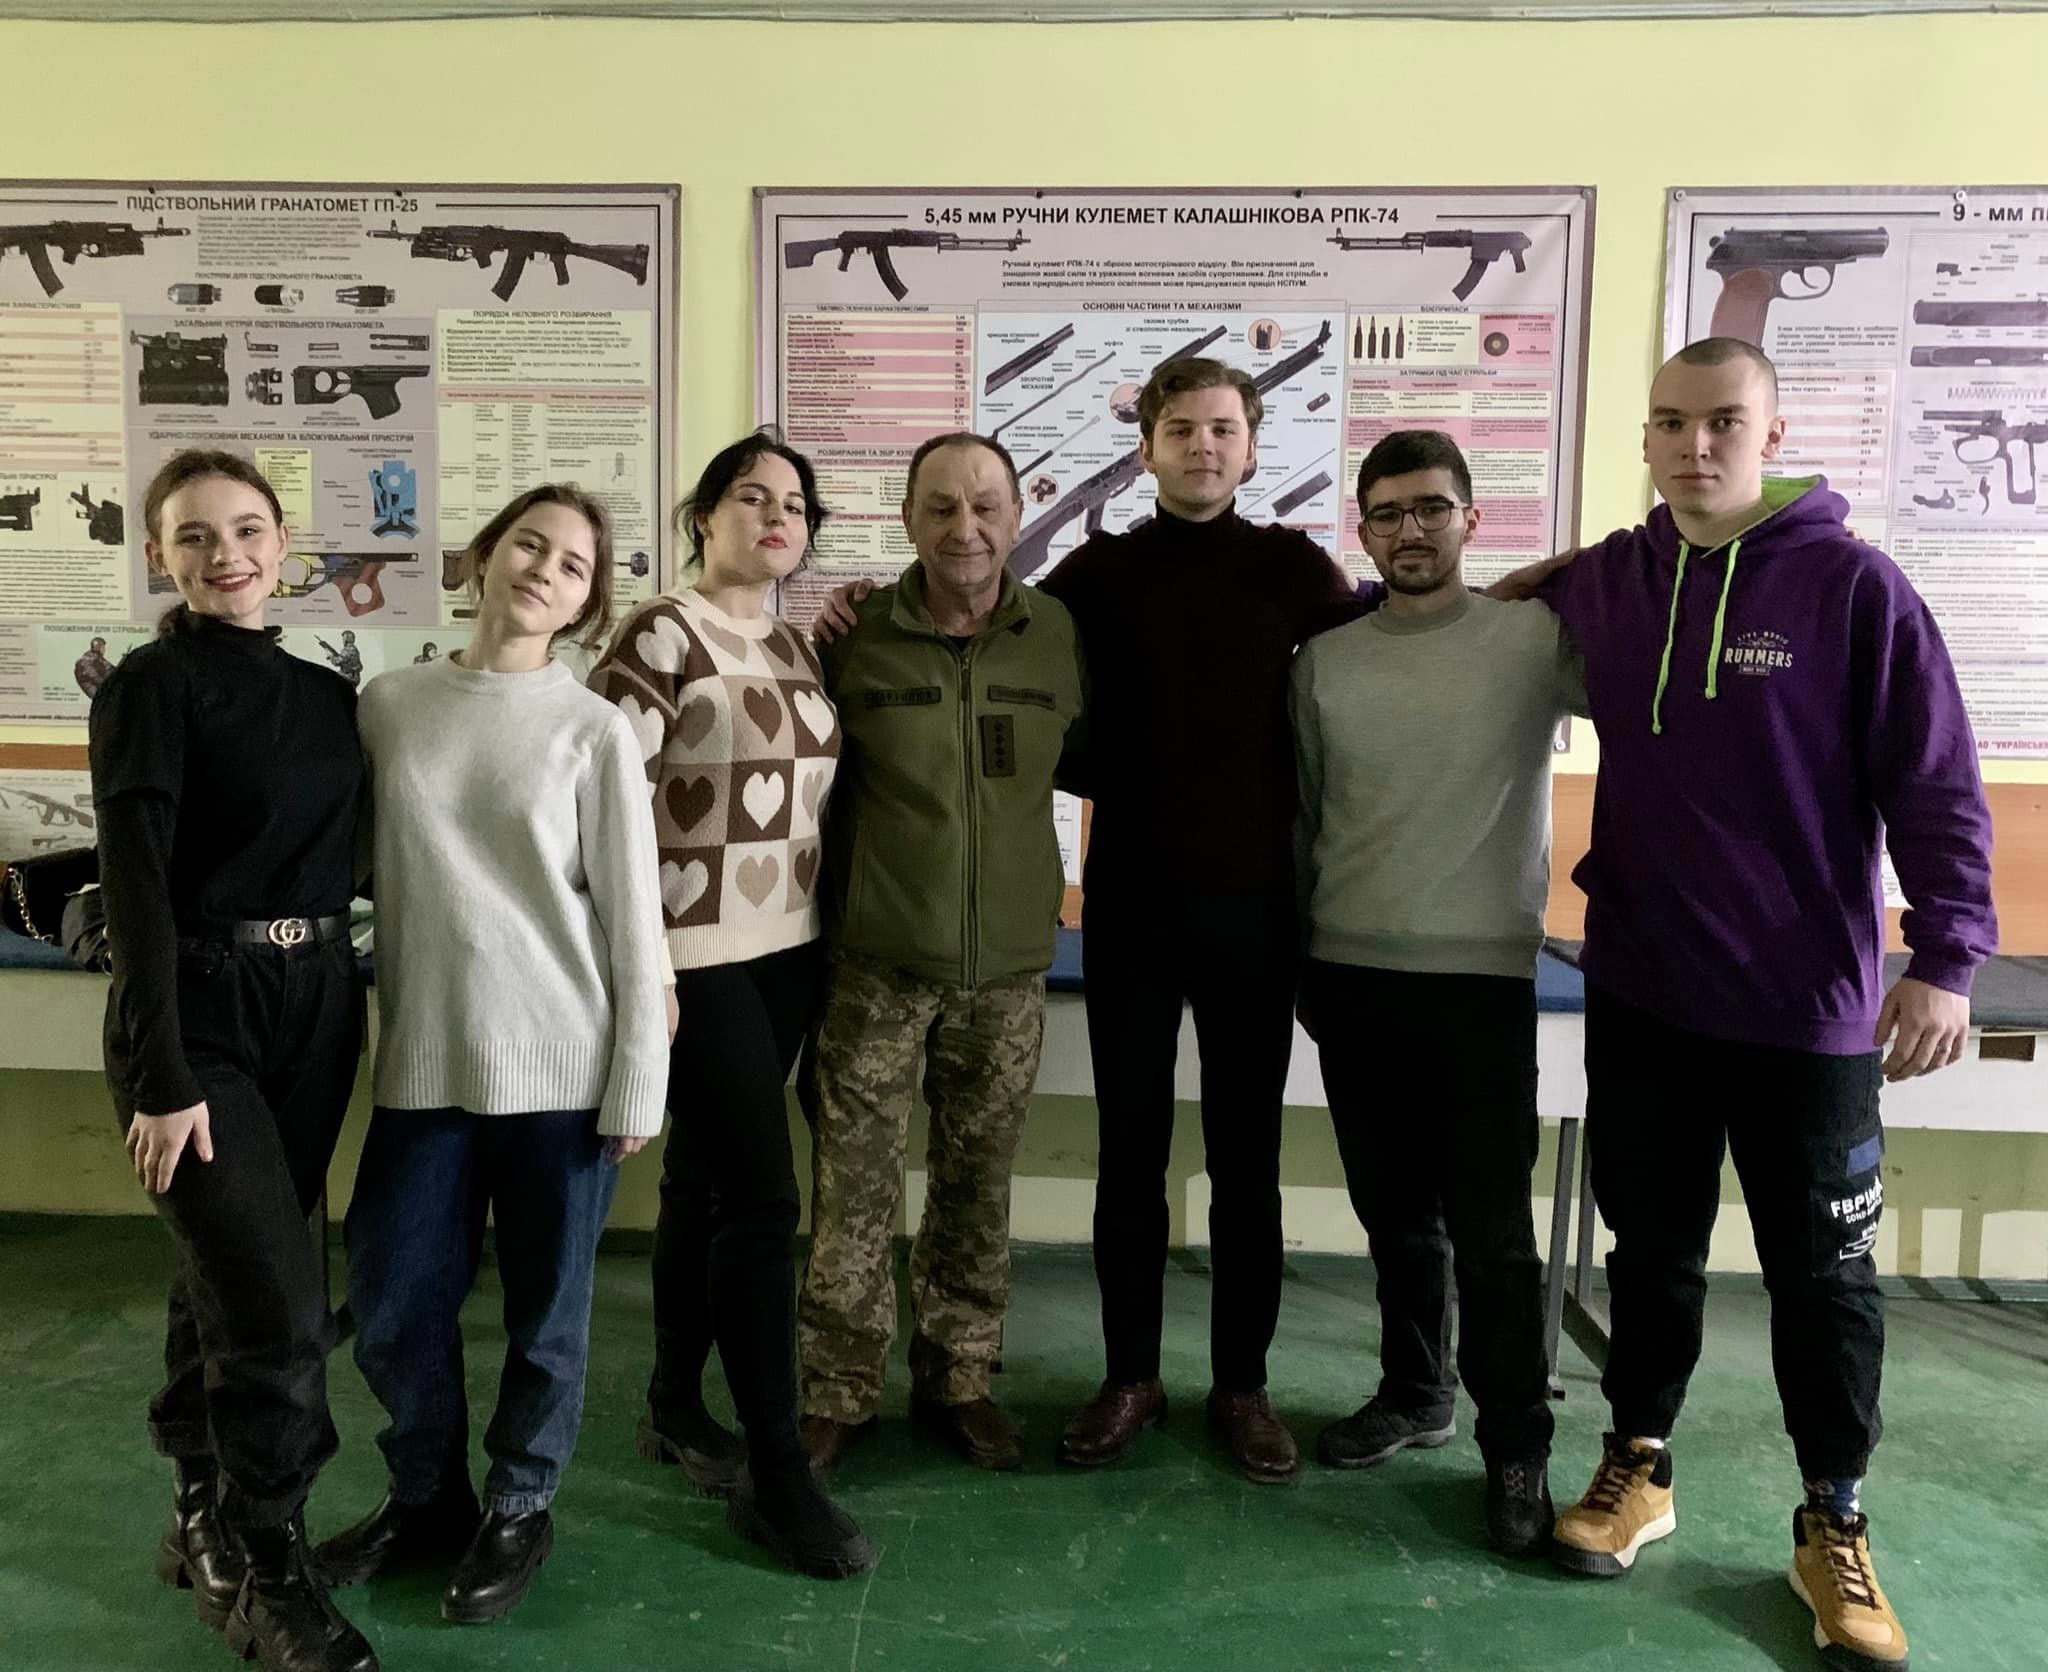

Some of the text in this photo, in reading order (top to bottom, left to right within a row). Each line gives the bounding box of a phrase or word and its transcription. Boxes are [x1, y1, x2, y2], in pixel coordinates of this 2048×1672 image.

[127, 196, 423, 213] ПІДСТВОЛЬНИЙ ГРАНАТОМЕТ ГП-25
[1953, 203, 1965, 221] 9
[925, 208, 1398, 226] 5,45 мм РУЧНИ КУЛЕМЕТ КАЛАШНІКОВА РПК-74
[1083, 303, 1241, 311] ОСНОВНІ ЧАСТИНИ ТА МЕХАНІЗМИ
